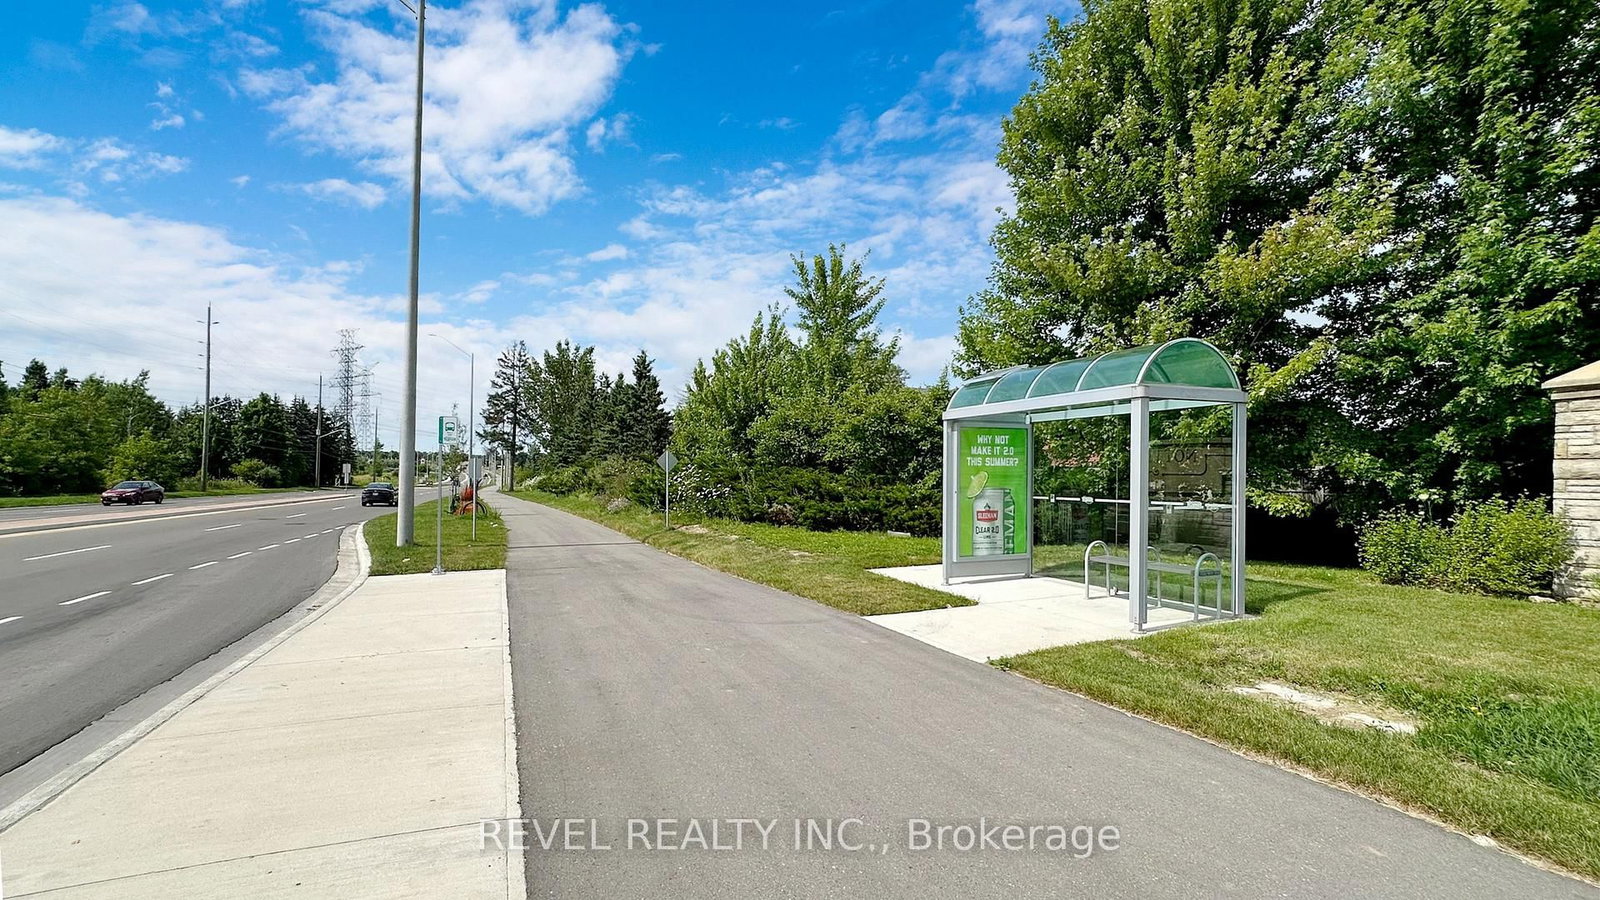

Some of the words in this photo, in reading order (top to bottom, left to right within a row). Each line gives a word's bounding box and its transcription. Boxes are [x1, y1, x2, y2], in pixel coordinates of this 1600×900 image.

[977, 435, 992, 444] WHY
[995, 435, 1010, 444] NOT
[971, 446, 991, 455] MAKE
[994, 446, 1000, 455] IT
[1003, 446, 1014, 455] 2.0
[966, 457, 982, 466] THIS
[985, 457, 1019, 466] SUMMER?
[975, 525, 990, 534] CLEAR
